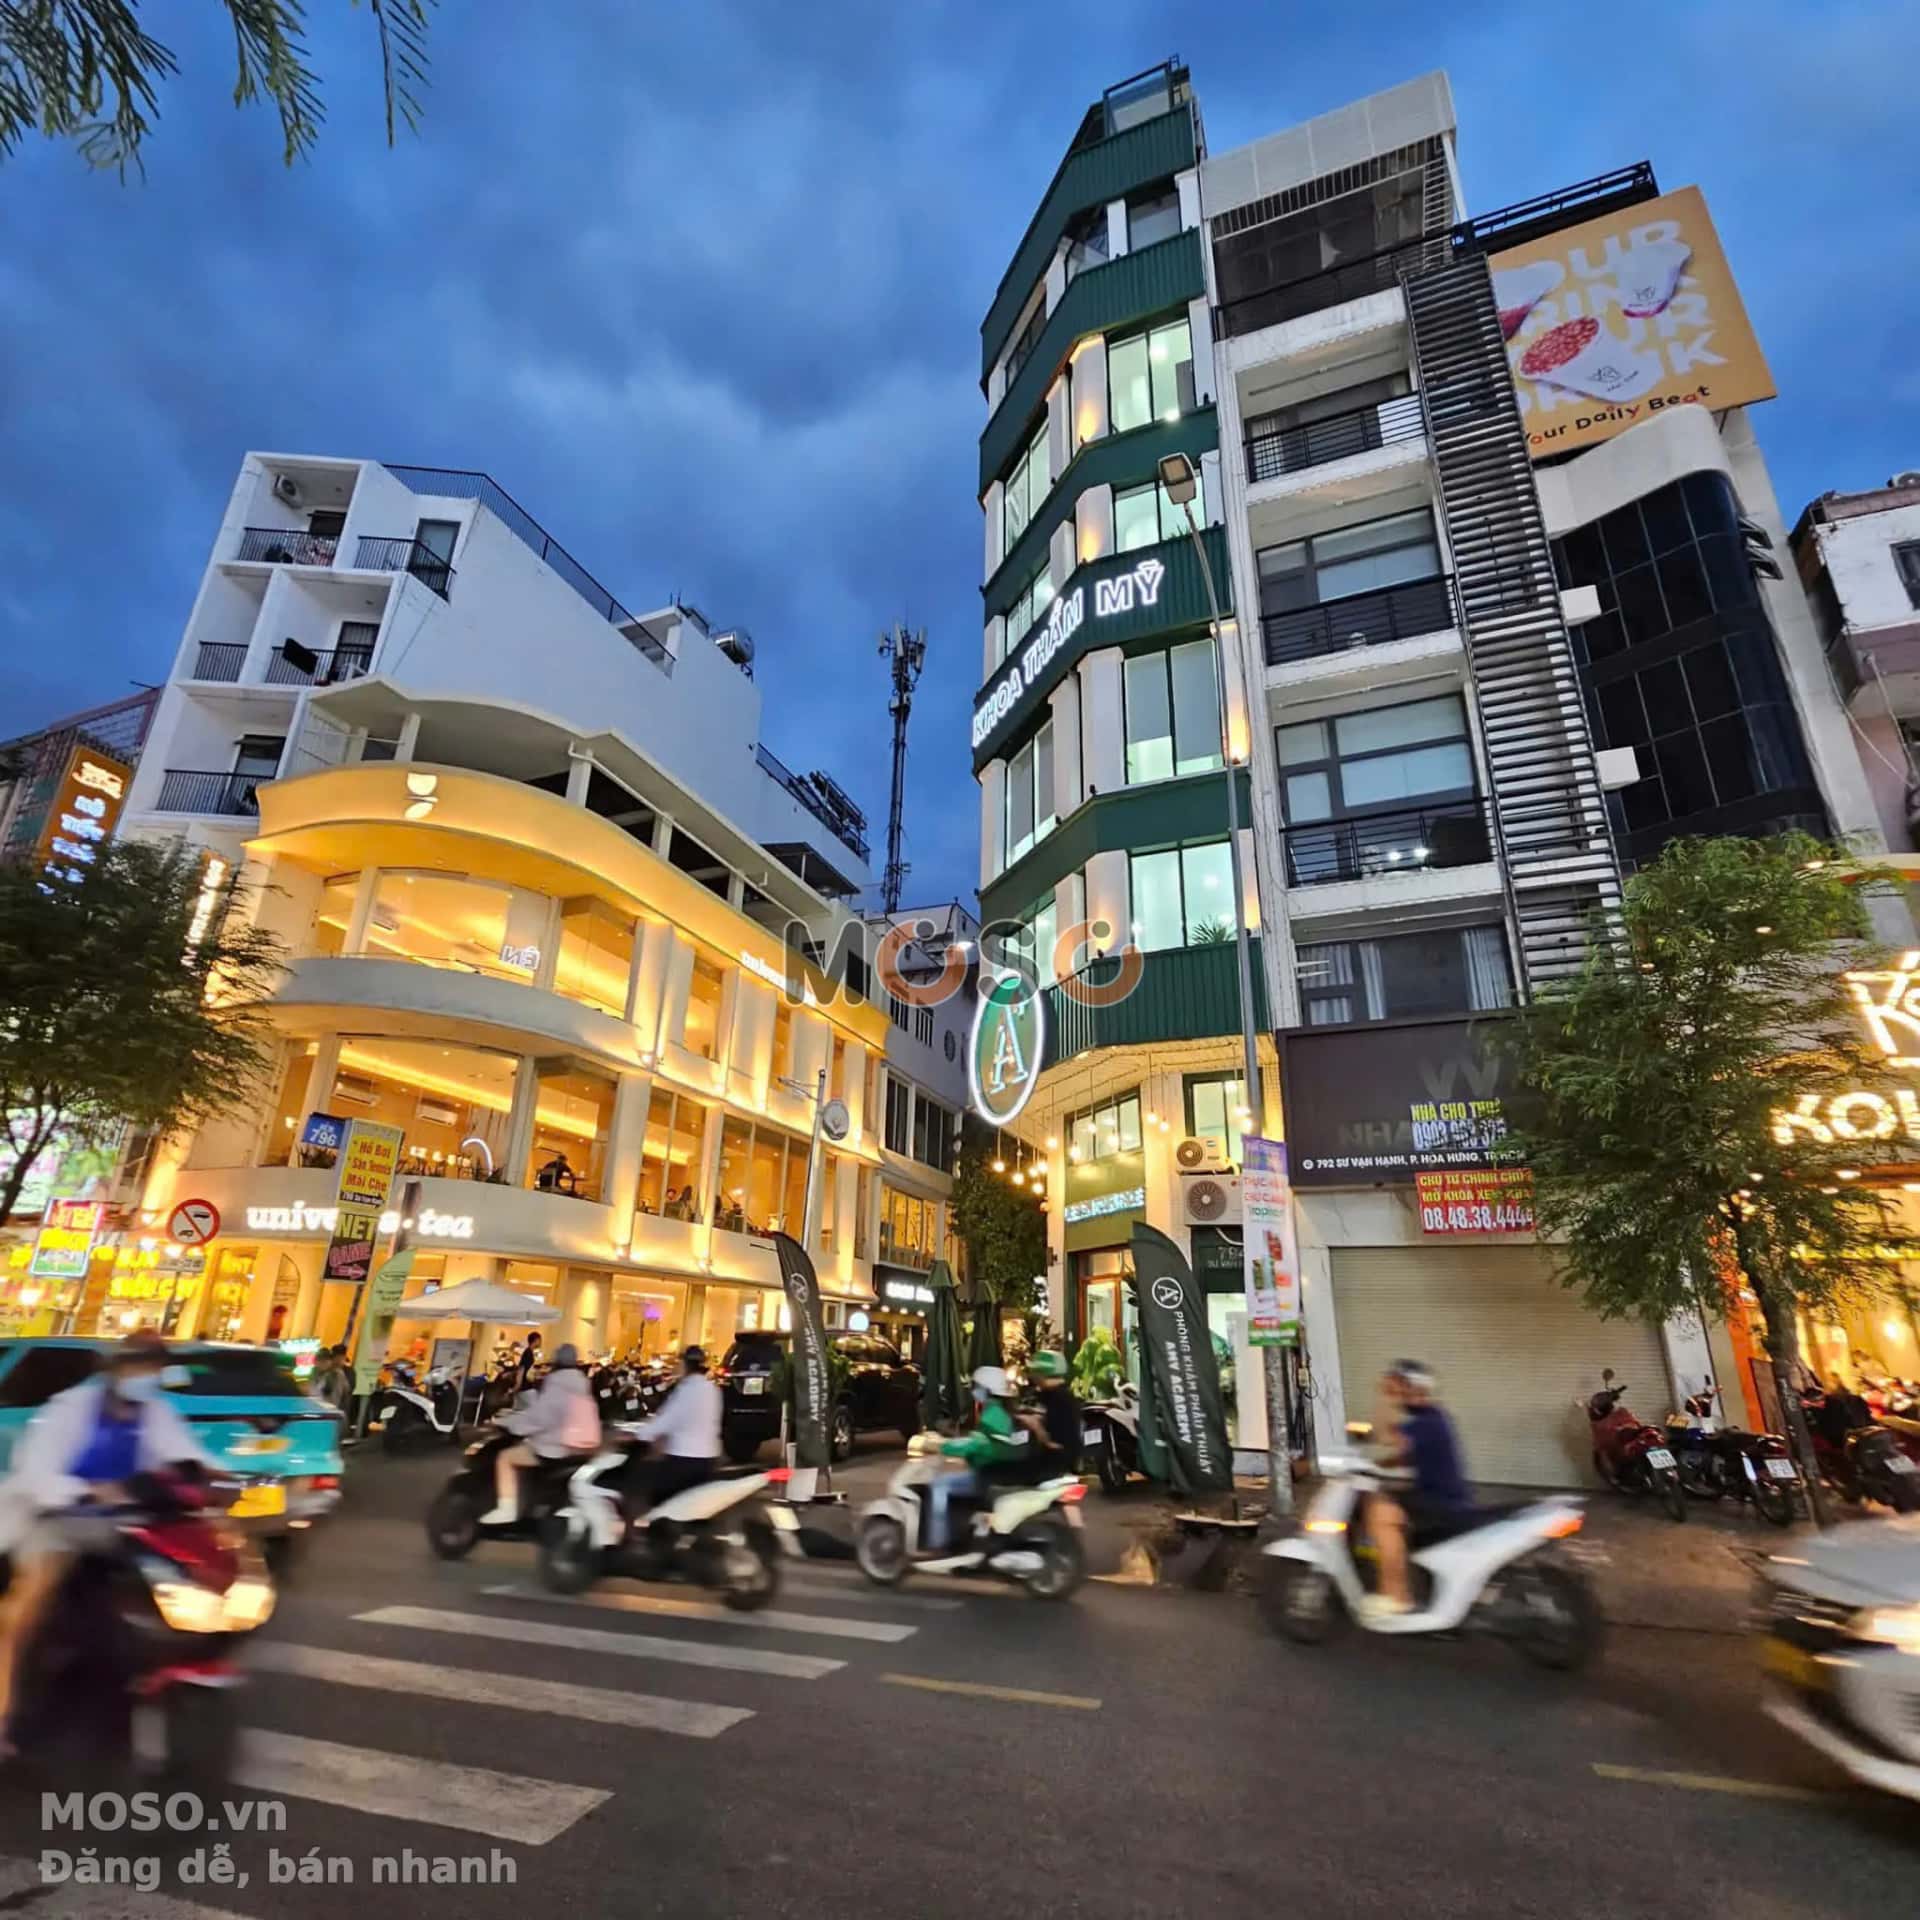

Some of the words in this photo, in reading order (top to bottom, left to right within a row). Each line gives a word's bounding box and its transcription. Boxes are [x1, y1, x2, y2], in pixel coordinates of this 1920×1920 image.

[1575, 405, 1641, 431] Daily
[1648, 385, 1710, 411] Beat
[972, 667, 1024, 748] KHOA
[1095, 559, 1165, 617] MỸ
[1440, 1102, 1467, 1120] CHO
[309, 1129, 337, 1147] 796
[1317, 1158, 1334, 1169] 792
[336, 1213, 380, 1241] NET
